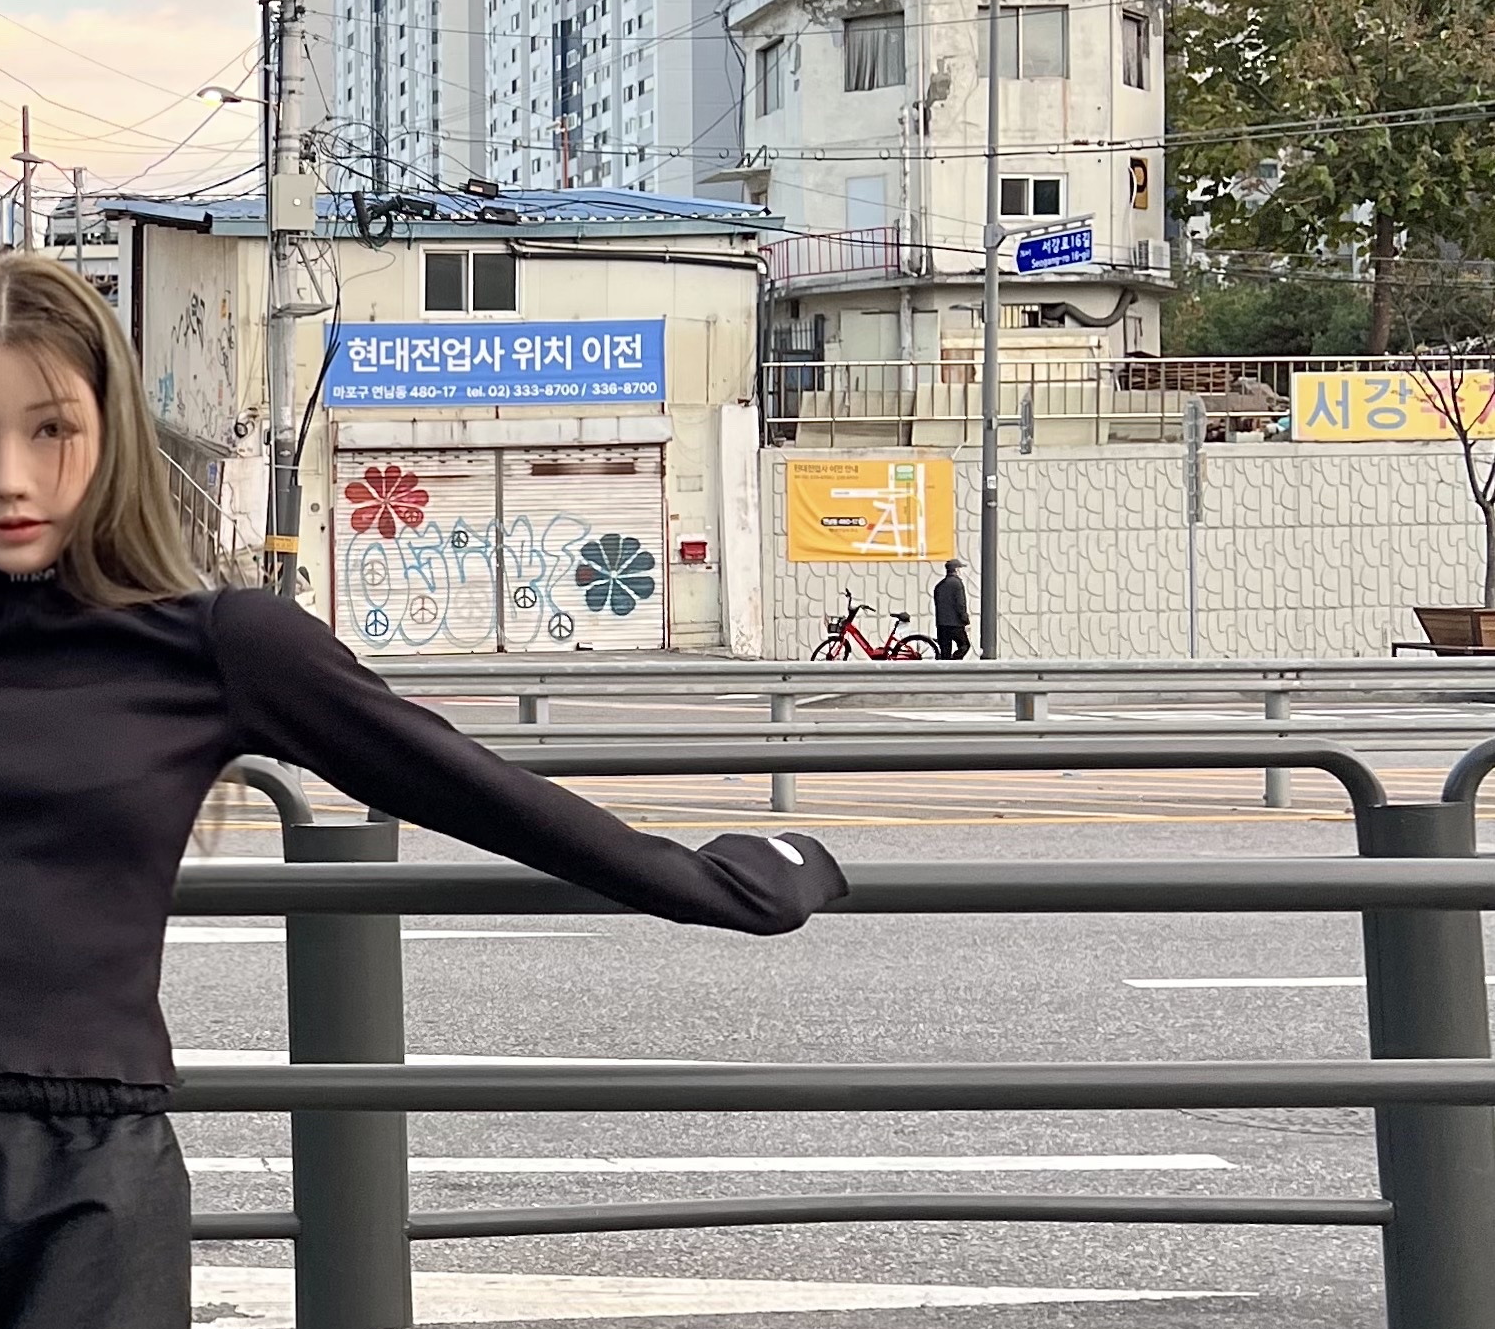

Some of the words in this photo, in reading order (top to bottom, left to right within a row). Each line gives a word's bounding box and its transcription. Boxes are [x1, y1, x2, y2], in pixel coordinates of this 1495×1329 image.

[347, 336, 504, 373] 현대전업사
[512, 335, 572, 372] 위치
[582, 333, 643, 370] 이전
[333, 385, 369, 399] 마포구
[372, 385, 407, 400] 연남동
[410, 385, 456, 398] 480-17
[488, 385, 510, 399] 02)
[514, 384, 579, 397] 333-8700
[592, 382, 657, 395] 336-8700
